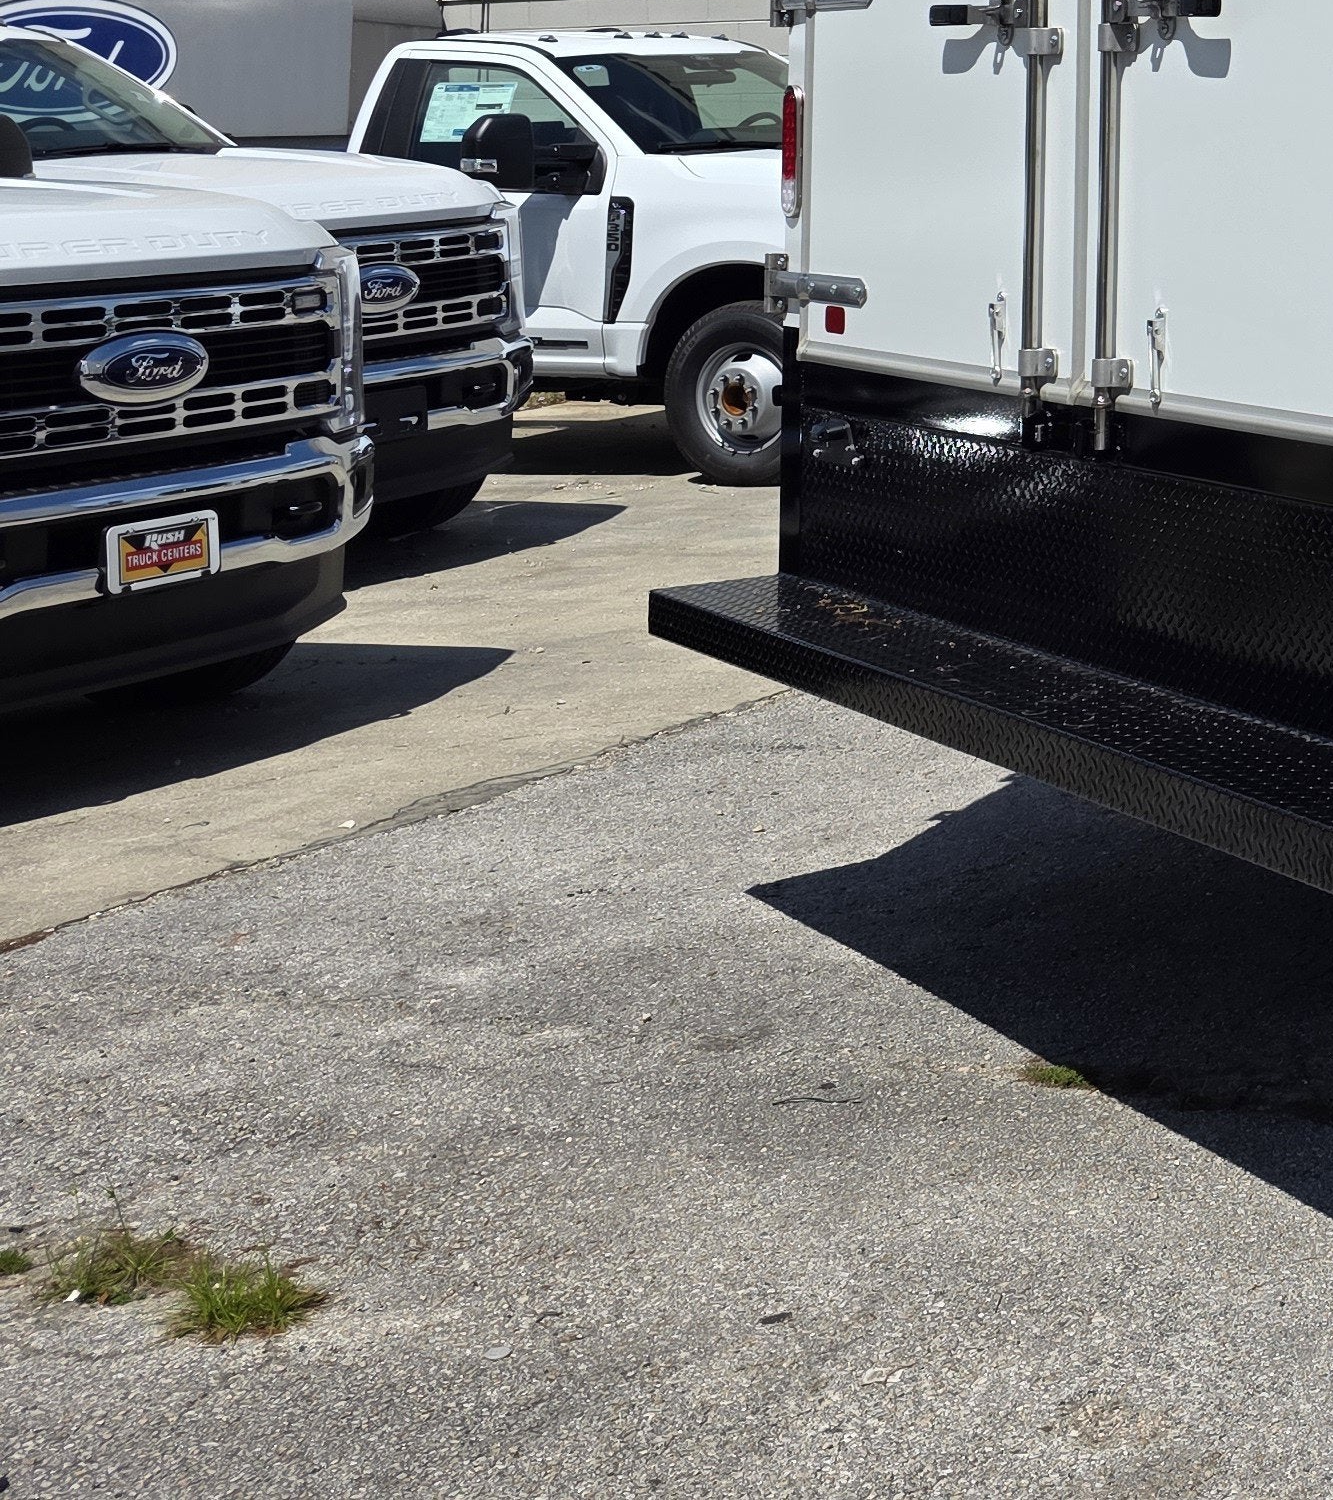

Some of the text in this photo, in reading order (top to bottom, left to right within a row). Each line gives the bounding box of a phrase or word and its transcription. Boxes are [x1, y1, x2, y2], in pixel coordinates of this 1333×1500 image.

[144, 229, 269, 252] DUTY
[364, 278, 403, 300] Ford
[125, 352, 184, 383] Ford
[127, 544, 203, 568] TRUCK CENTERS
